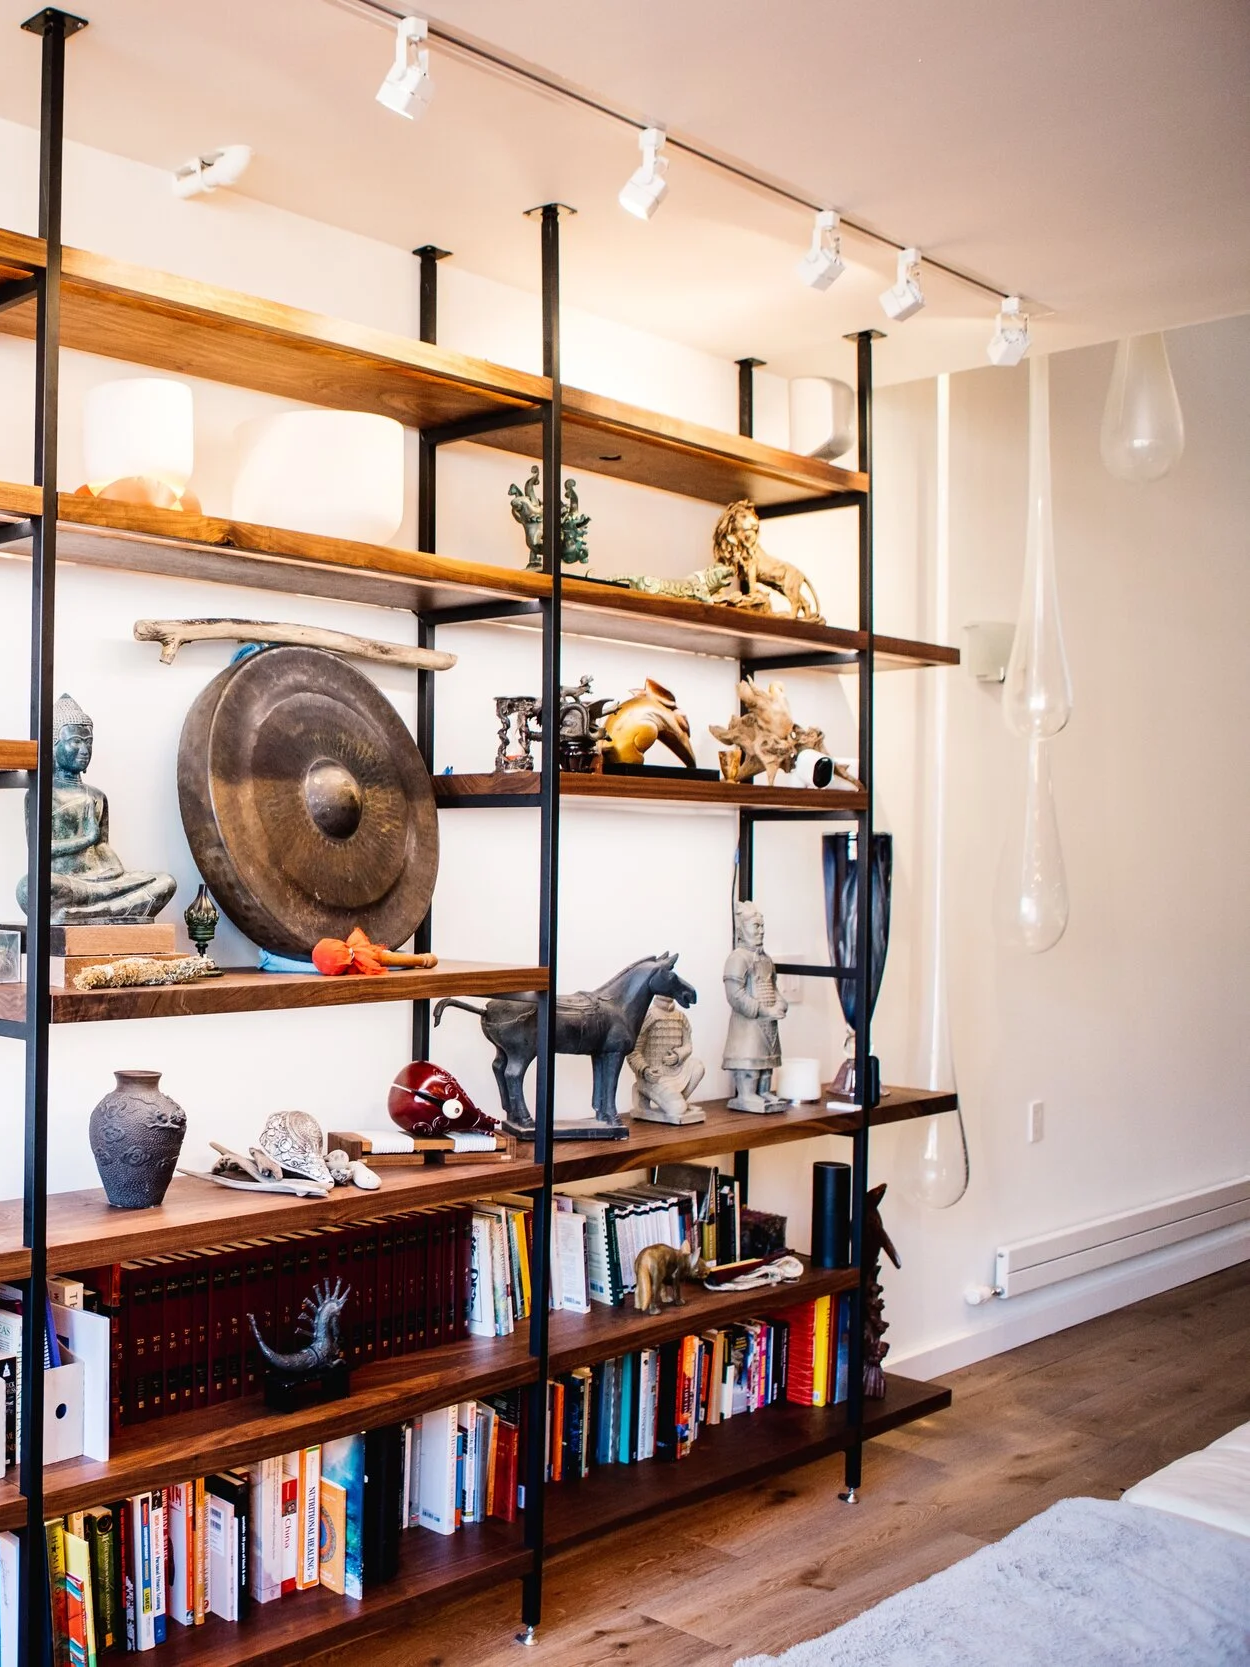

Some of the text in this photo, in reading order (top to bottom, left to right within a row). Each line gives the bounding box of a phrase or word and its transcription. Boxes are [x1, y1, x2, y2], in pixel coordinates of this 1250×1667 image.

[284, 1518, 292, 1549] China
[307, 1486, 316, 1571] NUTRITIONAL HEALING
